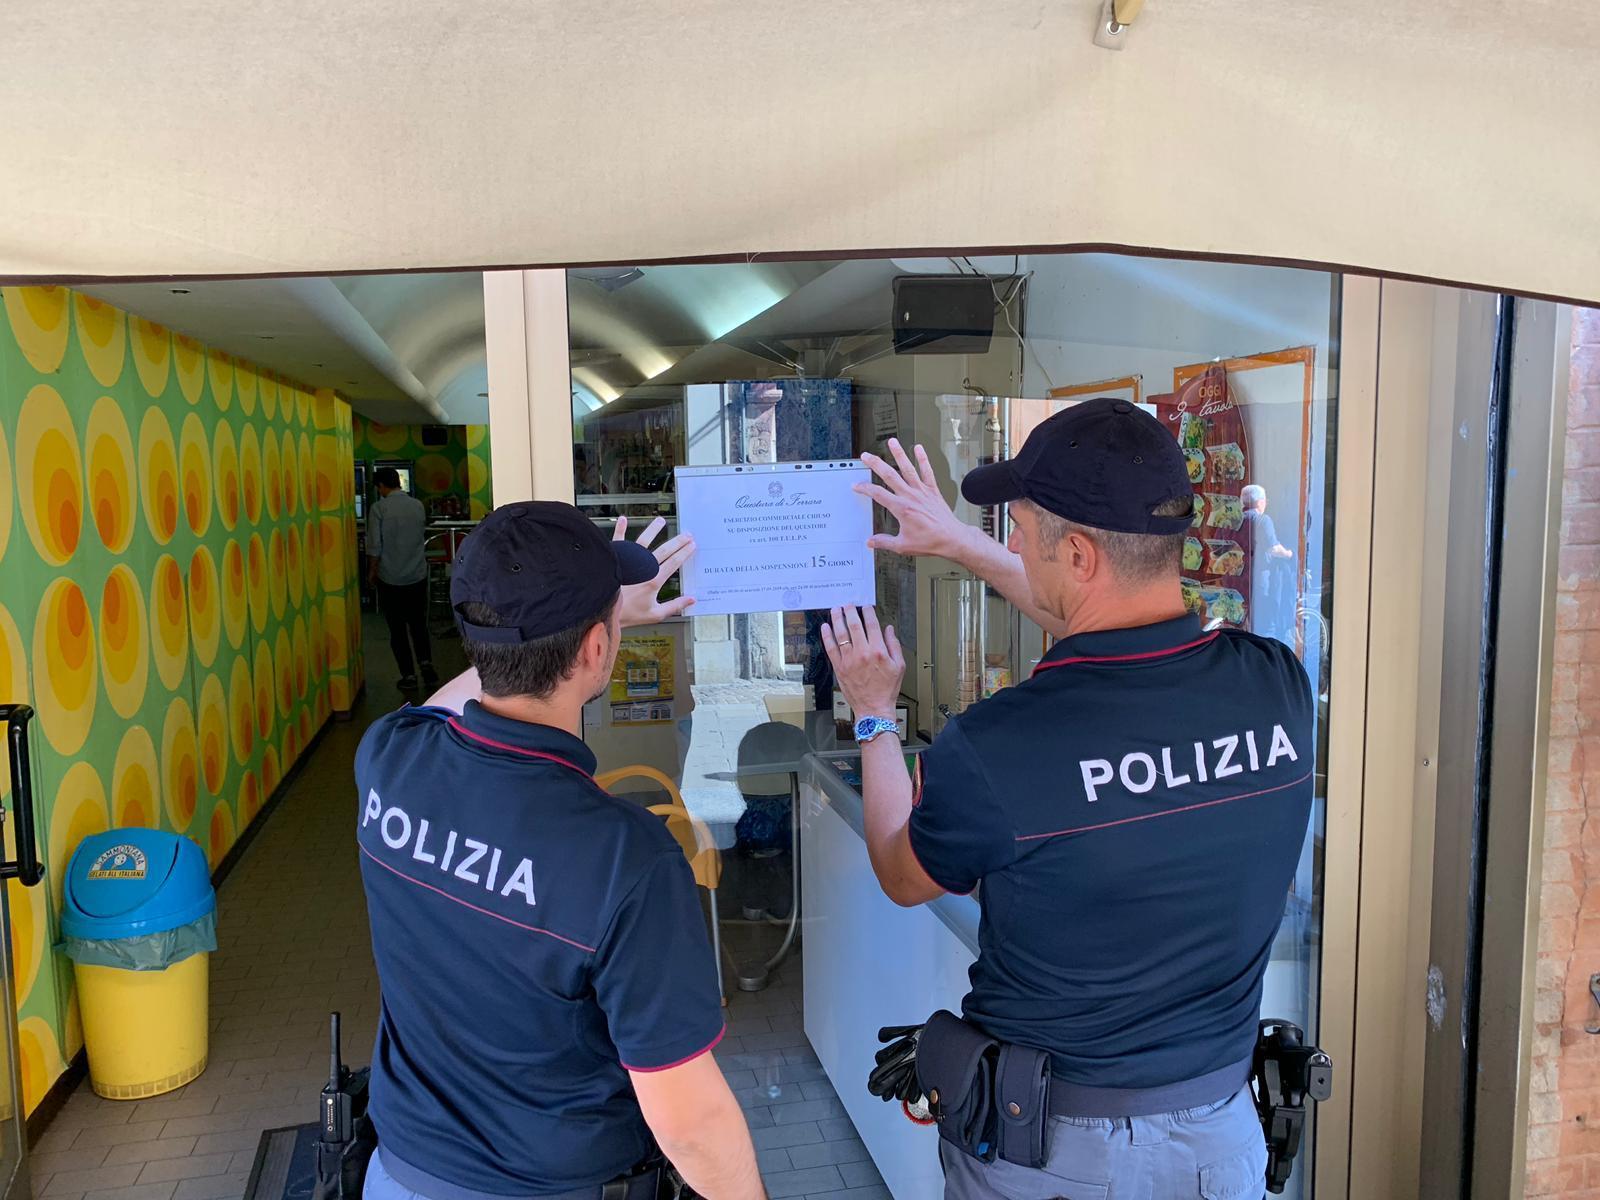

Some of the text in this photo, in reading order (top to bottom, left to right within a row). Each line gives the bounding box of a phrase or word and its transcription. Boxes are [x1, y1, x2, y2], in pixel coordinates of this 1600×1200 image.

[735, 492, 823, 508] Questura di Ferrara
[723, 512, 831, 524] ESERCIZIO COMMERCIALE CHIUSO
[736, 525, 780, 533] DISPOSIZIONE
[793, 523, 827, 531] QUESTORE
[704, 555, 854, 574] DURATA DELLA SOSPENSIONE 15 GIORNI
[1079, 724, 1298, 803] POLIZIA
[96, 844, 145, 866] SAMMONTANA
[362, 787, 536, 906] POLIZIA
